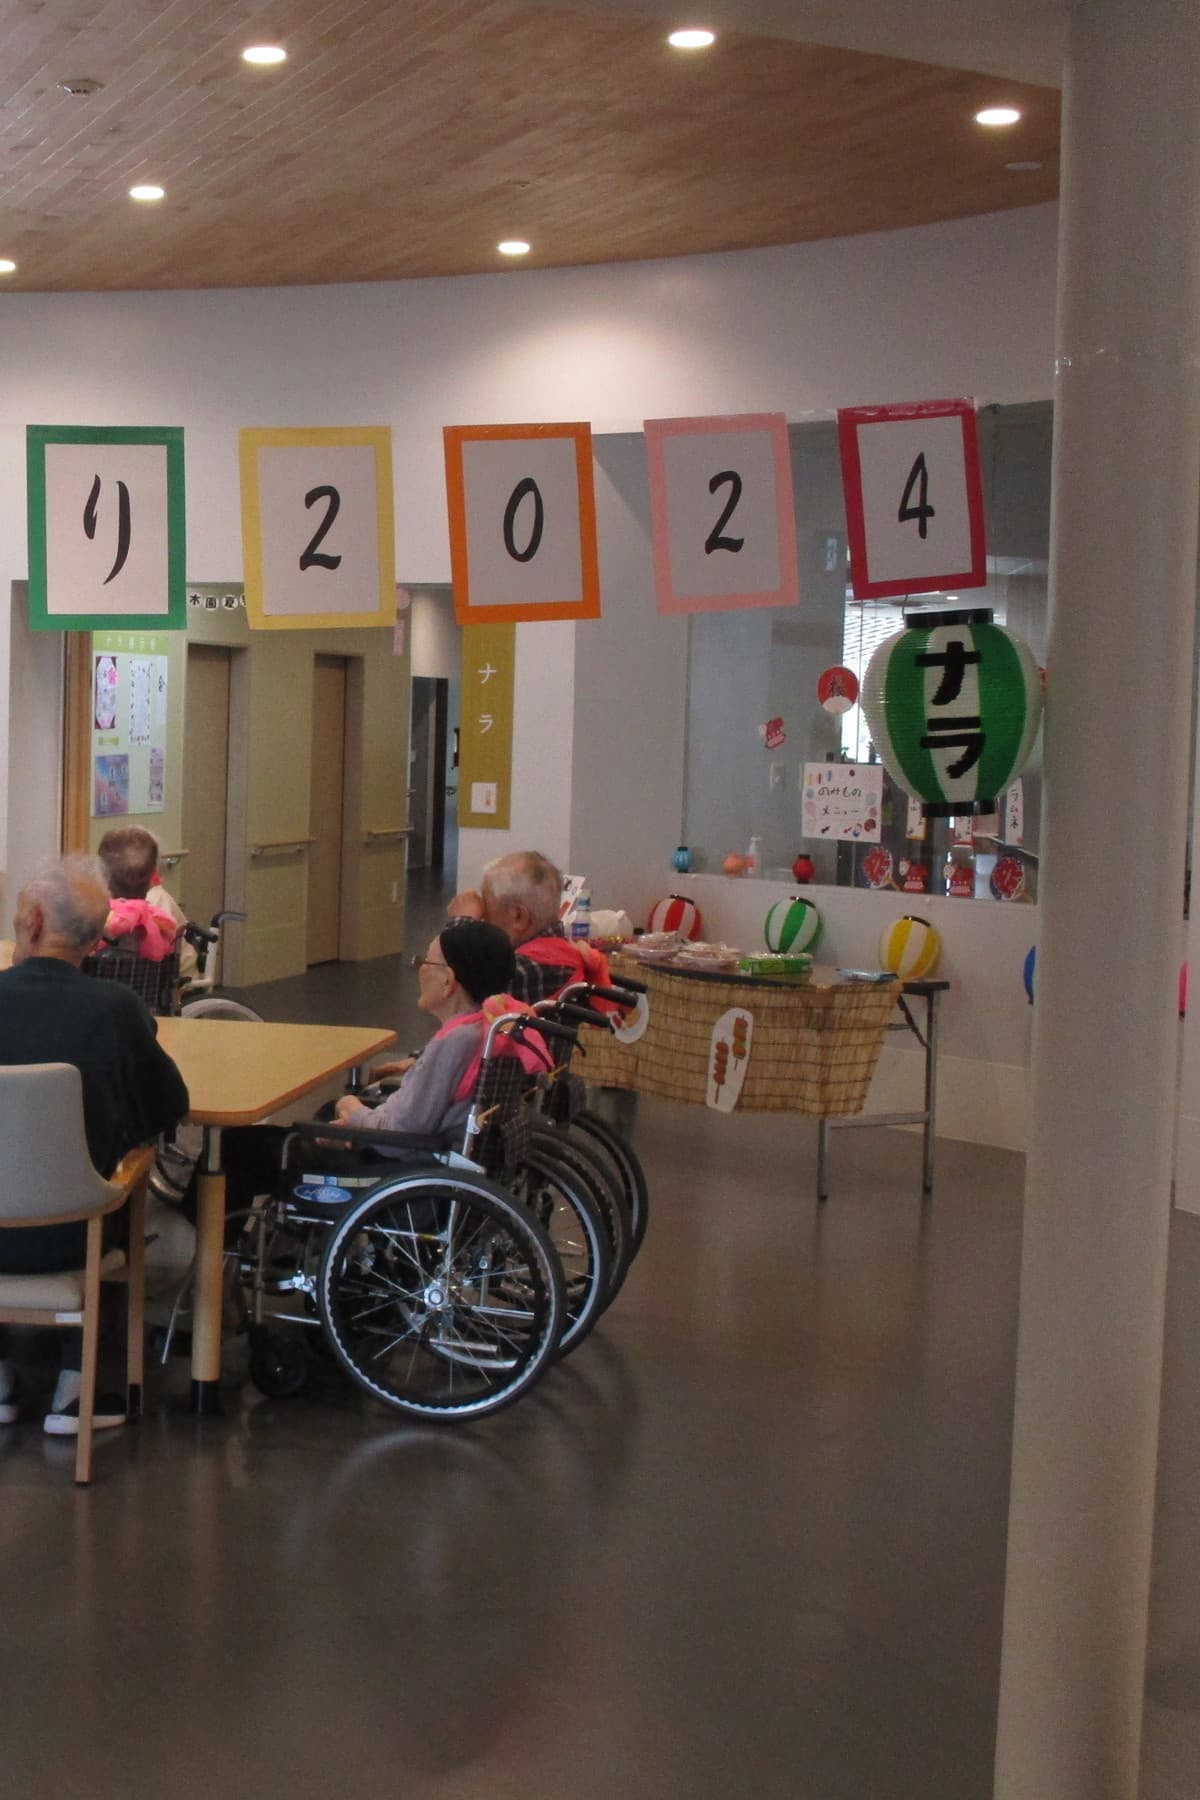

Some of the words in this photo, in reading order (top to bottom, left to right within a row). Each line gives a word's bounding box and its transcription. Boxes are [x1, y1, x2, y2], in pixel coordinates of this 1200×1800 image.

[477, 663, 497, 734] ナラ
[914, 641, 986, 779] ナラ
[818, 785, 862, 798] のみもの
